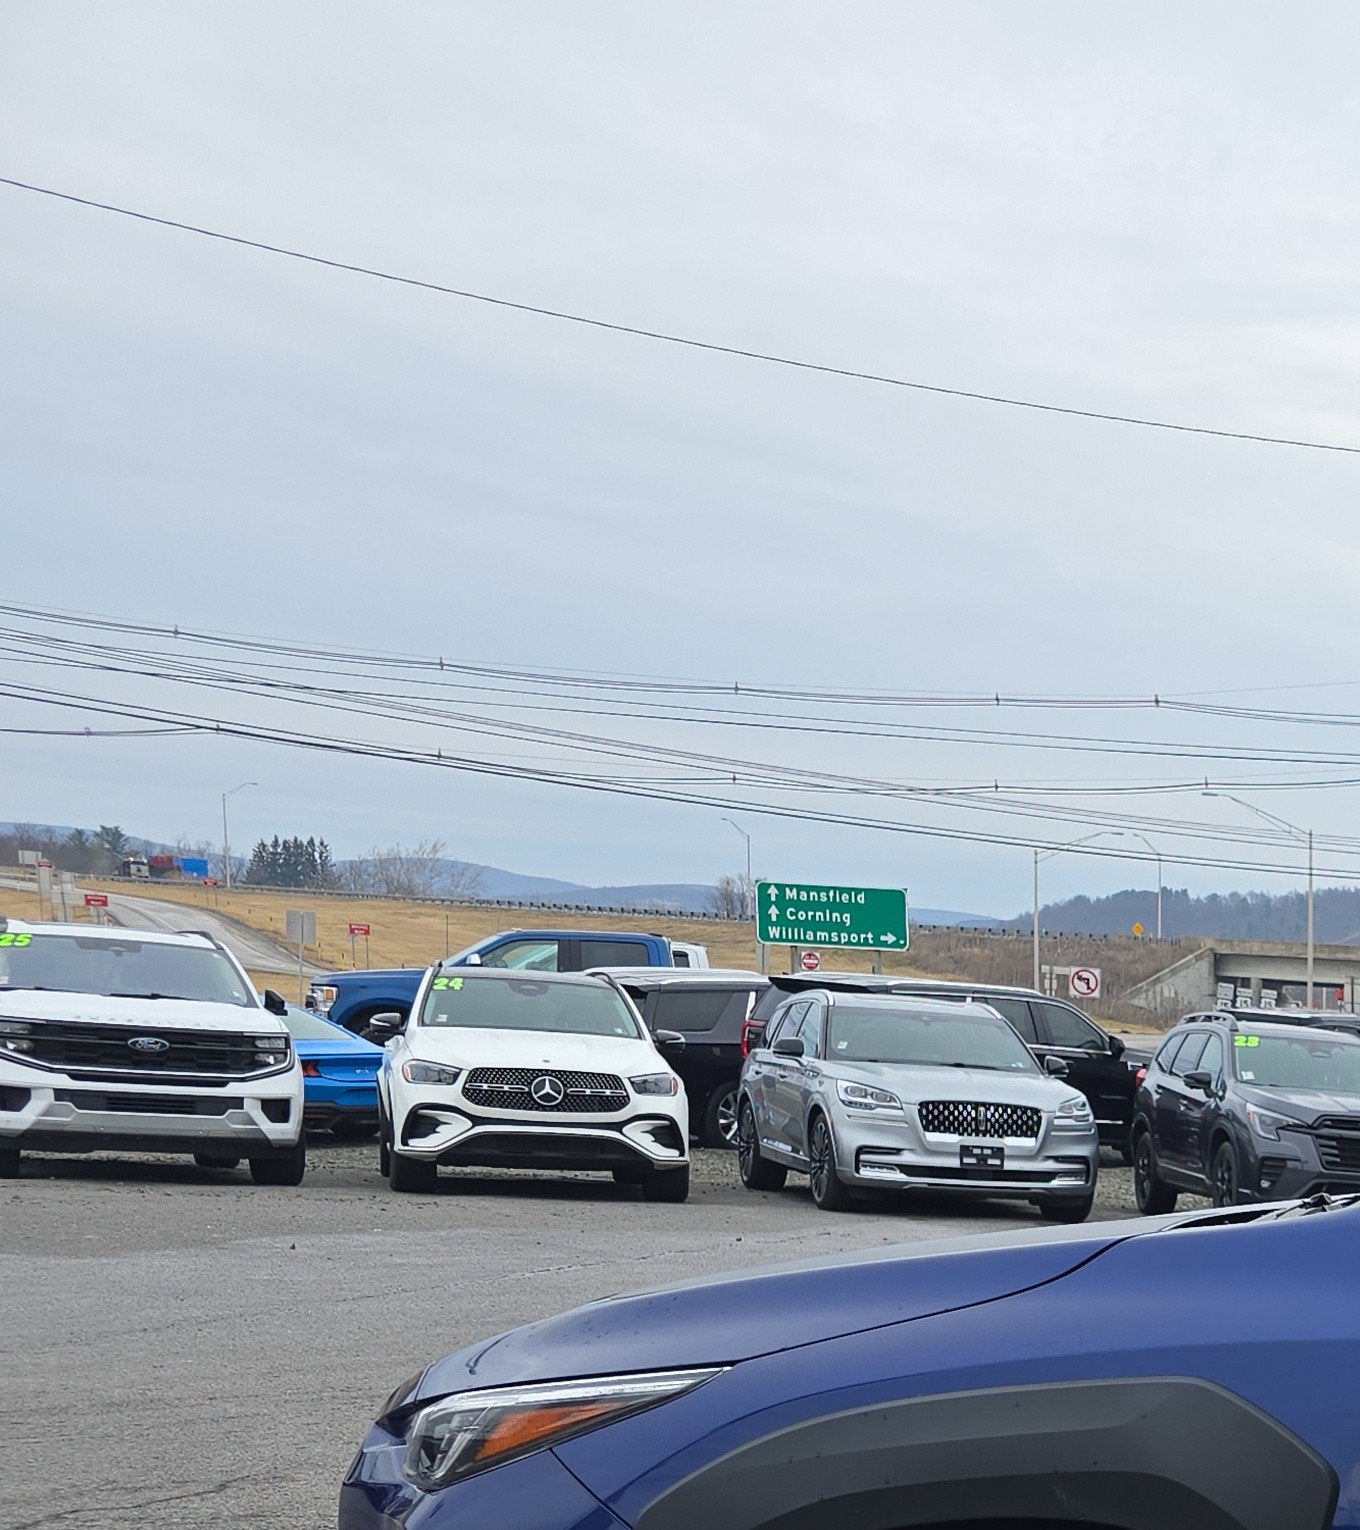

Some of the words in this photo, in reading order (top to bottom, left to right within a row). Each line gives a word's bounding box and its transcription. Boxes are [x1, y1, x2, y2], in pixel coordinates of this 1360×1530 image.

[785, 887, 865, 904] Mansfield
[786, 907, 851, 927] Corning
[0, 933, 33, 947] 25
[768, 926, 874, 945] Williamsport
[433, 977, 463, 990] 24
